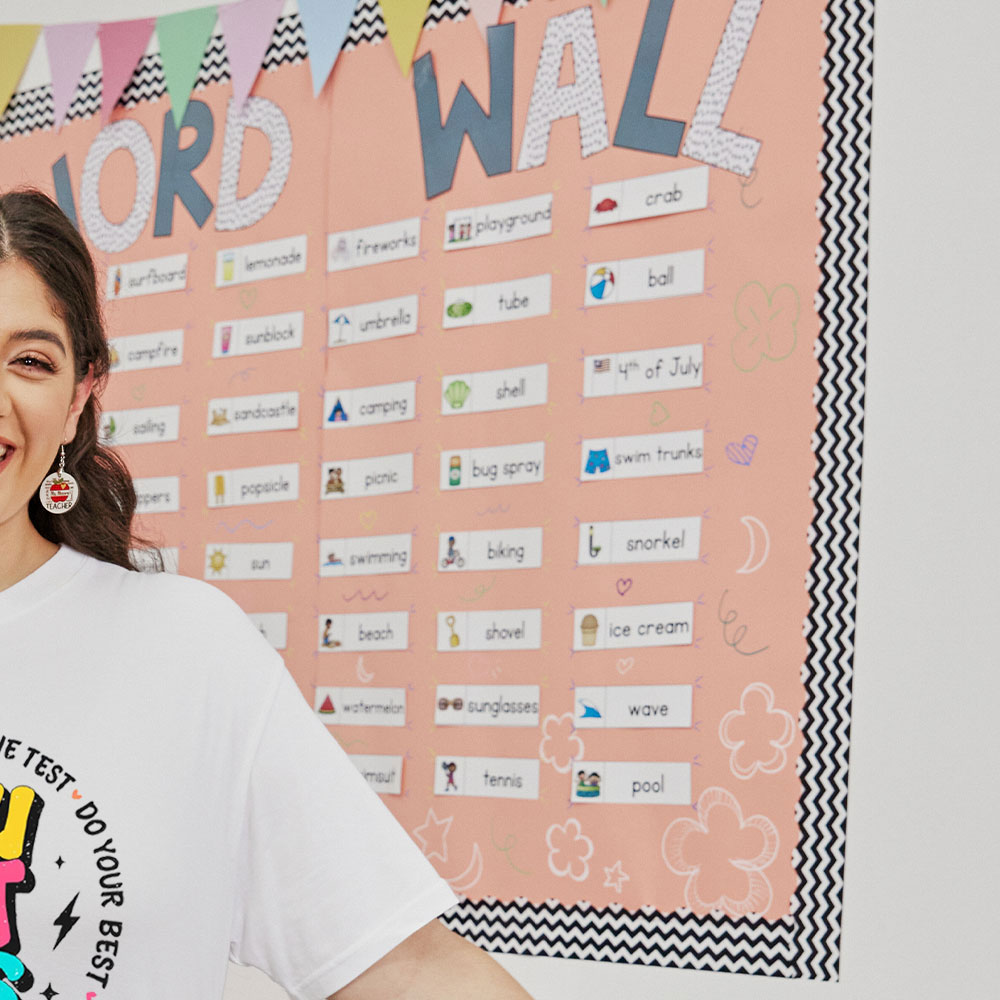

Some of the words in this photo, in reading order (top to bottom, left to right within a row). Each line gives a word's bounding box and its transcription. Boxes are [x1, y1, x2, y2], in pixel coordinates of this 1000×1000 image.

[52, 97, 293, 253] ORD
[413, 0, 762, 200] WALL
[645, 182, 683, 206] crab
[475, 202, 552, 236] playground
[356, 232, 417, 257] fireworks
[245, 248, 301, 272] lemonade
[128, 263, 187, 288] surfboard
[648, 266, 674, 288] ball
[499, 291, 529, 311] tube
[360, 308, 412, 332] umbrella
[246, 323, 295, 346] sunblock
[128, 342, 178, 363] campfire
[618, 360, 639, 380] 4th
[645, 359, 664, 379] of
[669, 356, 701, 379] July
[496, 378, 525, 399] shell
[234, 400, 296, 421] sandcastle
[359, 398, 408, 417] camping
[133, 420, 166, 437] sailing
[615, 451, 651, 465] swim
[657, 442, 703, 461] trunks
[364, 471, 398, 489] picnic
[472, 459, 498, 482] bug
[502, 460, 541, 480] spray
[241, 474, 290, 496] popsicle
[137, 491, 170, 506] ppers
[626, 529, 686, 552] snorkel
[349, 550, 408, 566] swimming
[487, 541, 525, 563] biking
[251, 558, 270, 570] sun
[358, 623, 394, 642] beach
[485, 621, 526, 642] shovel
[609, 623, 630, 638] ice
[637, 621, 689, 636] cream
[342, 699, 405, 714] watermelon
[468, 696, 539, 718] sunglasses
[628, 704, 669, 717] wave
[23, 746, 77, 793] TEST
[361, 769, 396, 783] imsuit
[483, 770, 523, 789] tennis
[632, 773, 665, 797] pool
[75, 801, 107, 836] DO
[93, 838, 124, 908] YOUR
[86, 921, 123, 989] BEST
